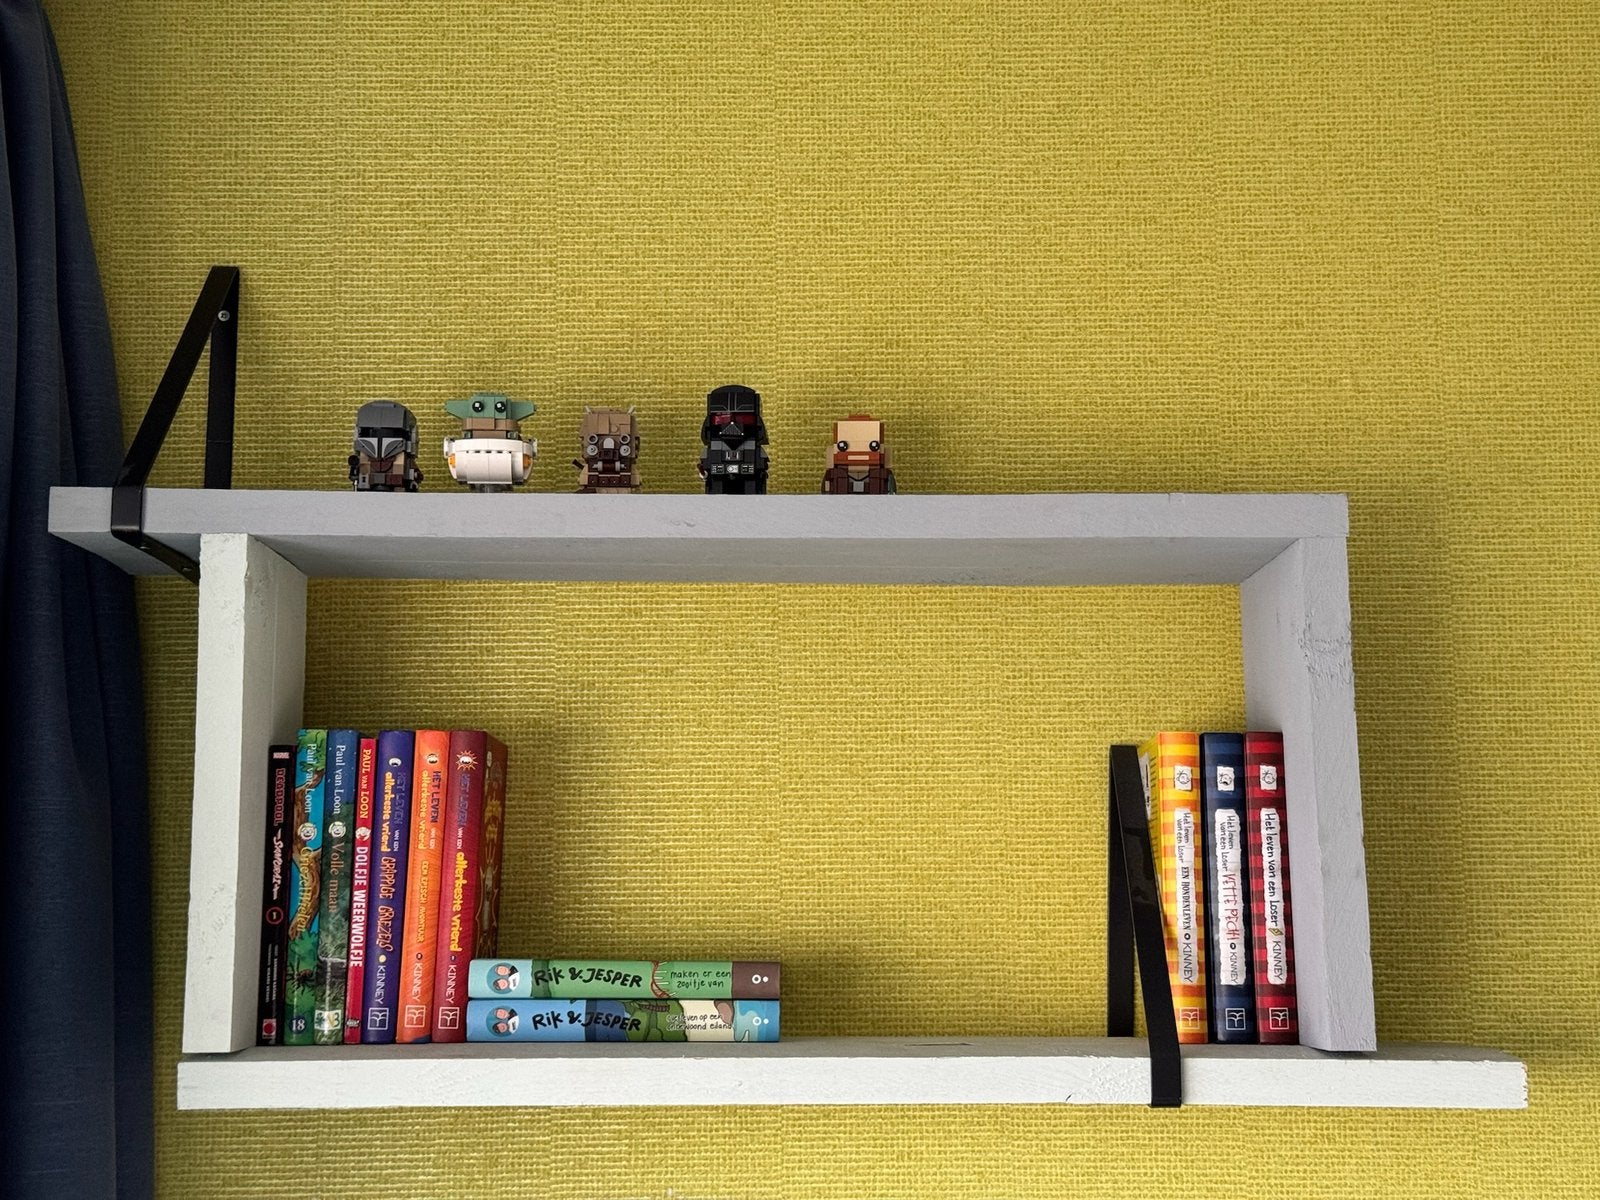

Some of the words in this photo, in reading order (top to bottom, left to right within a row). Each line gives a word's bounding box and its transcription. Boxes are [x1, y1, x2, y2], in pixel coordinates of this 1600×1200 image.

[306, 743, 317, 764] Paul
[335, 745, 346, 766] Paul
[361, 749, 372, 774] PAUL
[305, 767, 314, 785] van
[334, 769, 343, 786] van
[361, 775, 369, 789] VAN
[431, 770, 442, 790] HET
[274, 768, 286, 826] DEADPOOL
[304, 788, 315, 813] Loon
[333, 789, 345, 814] Loon
[360, 791, 370, 819] LOON
[382, 771, 396, 820] allerbeste
[430, 791, 441, 824] LEVEN
[1183, 812, 1191, 825] Het
[1226, 815, 1235, 829] Het
[1264, 812, 1276, 831] Het
[381, 821, 392, 853] vriend
[417, 819, 428, 850] vriend
[1226, 829, 1236, 850] leven
[1265, 832, 1278, 858] leven
[329, 842, 345, 876] Volle
[354, 846, 369, 886] DOLFJE
[1221, 851, 1230, 871] Loser
[1267, 859, 1277, 879] van
[379, 856, 398, 900] GRAPPIGE
[452, 852, 468, 912] allerbeste
[1181, 866, 1190, 880] EEN
[328, 880, 339, 913] maan
[1222, 873, 1237, 906] VETTE
[1267, 881, 1276, 897] een
[1181, 881, 1192, 931] HONDENLEVEN
[1269, 900, 1280, 927] Loser
[350, 889, 367, 968] WEERWOLFJE
[376, 905, 395, 952] GRIEZELS
[449, 914, 463, 952] vriend
[1182, 942, 1193, 983] KINNEY
[1229, 951, 1239, 984] KINNEY
[1272, 940, 1283, 981] KINNEY
[374, 965, 386, 1005] KINNEY
[412, 962, 423, 1002] KINNEY
[445, 964, 457, 1004] KINNEY
[533, 966, 565, 986] Rik
[582, 968, 643, 988] JESPER
[670, 970, 699, 978] maken
[702, 970, 713, 978] er
[715, 970, 731, 978] een
[676, 979, 706, 990] zooitje
[708, 980, 724, 988] van
[292, 1019, 305, 1032] 18
[531, 1010, 564, 1031] Rik
[581, 1011, 642, 1031] JESPER
[699, 1014, 708, 1022] op
